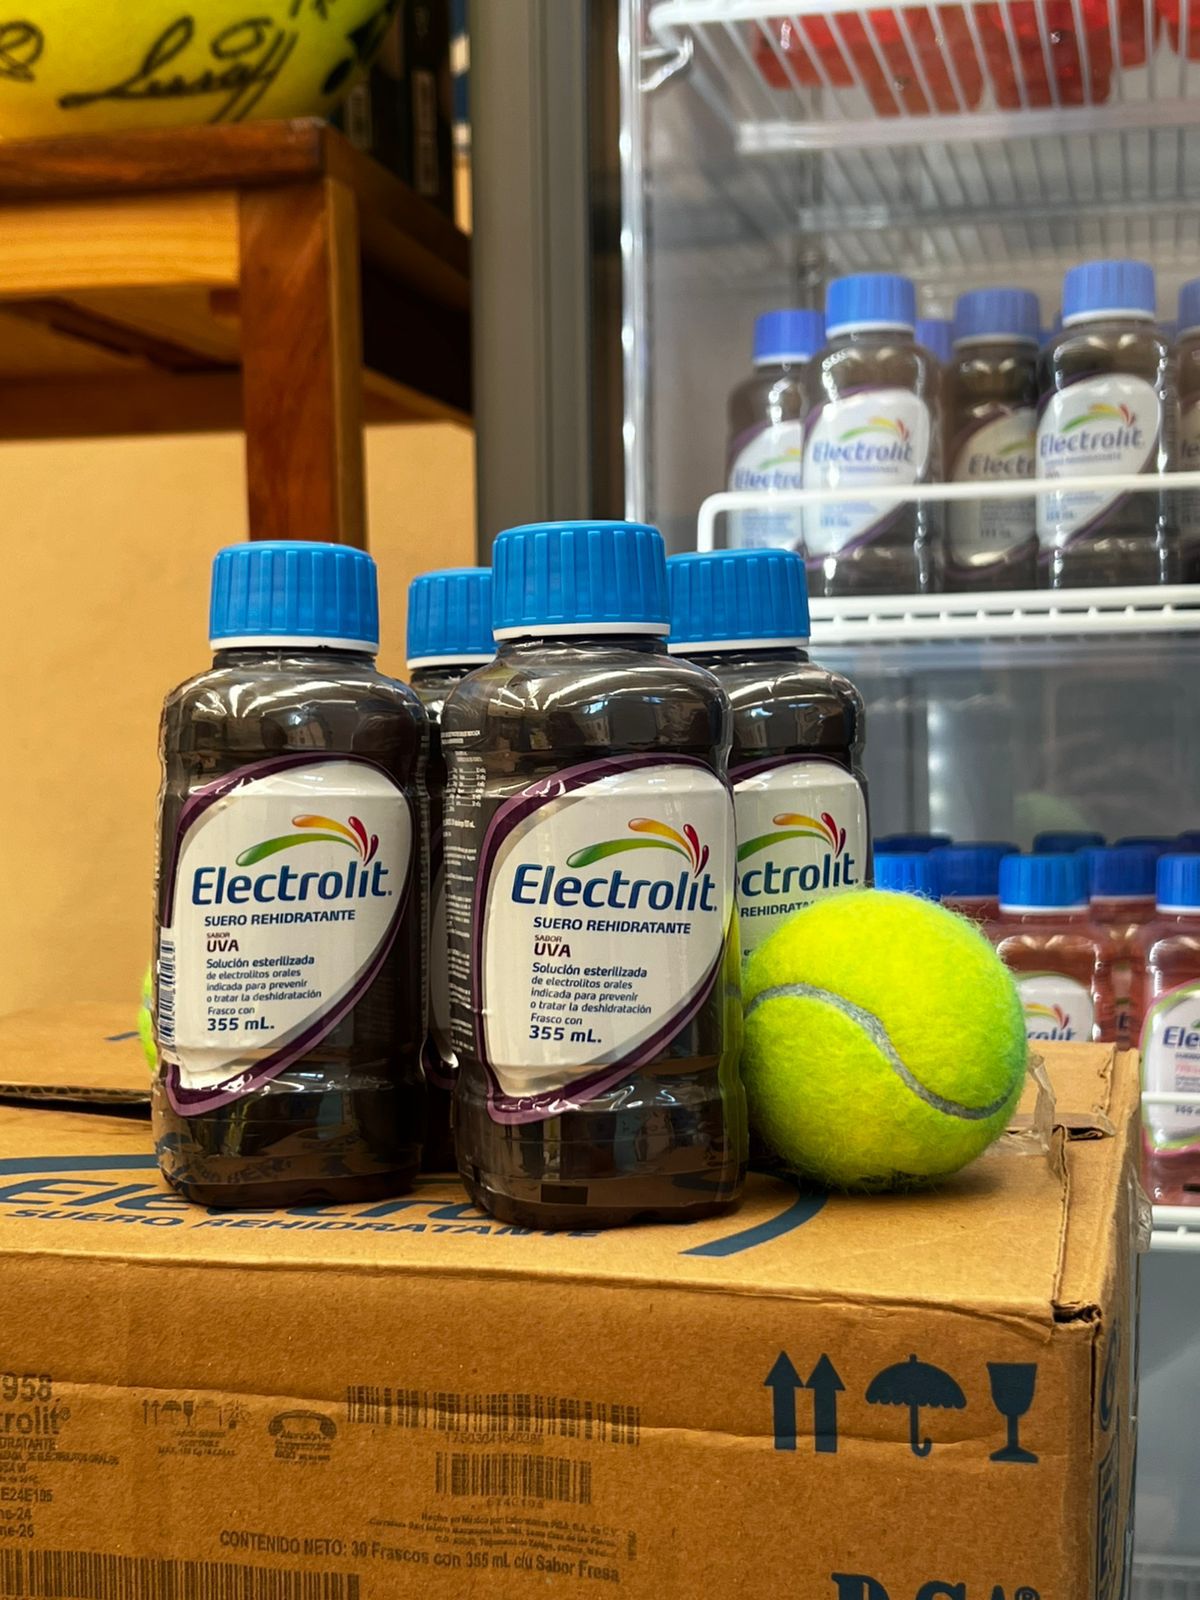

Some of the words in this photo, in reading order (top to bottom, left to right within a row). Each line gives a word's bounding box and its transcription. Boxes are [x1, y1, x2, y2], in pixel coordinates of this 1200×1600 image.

[740, 900, 815, 918] REHIDRAT
[204, 914, 247, 927] SUERO
[250, 909, 356, 925] REHIDRATANTE
[533, 916, 583, 931] SUERO
[586, 919, 692, 935] REHIDRATANTE
[206, 939, 240, 953] UVA
[534, 934, 563, 943] SABOR
[533, 942, 571, 958] UVA
[206, 957, 249, 969] Solución
[252, 954, 316, 967] esterilizada
[206, 972, 217, 980] de
[218, 970, 270, 980] electrolitos
[272, 969, 302, 978] orales
[532, 962, 580, 976] Solución
[583, 966, 648, 978] esterilizada
[206, 981, 243, 991] indicada
[245, 982, 267, 992] para
[268, 979, 308, 991] prevenir
[531, 975, 543, 985] de
[545, 976, 601, 989] electrolitos
[603, 979, 633, 990] orales
[213, 994, 238, 1003] tratar
[241, 993, 250, 1002] la
[252, 990, 322, 1002] deshidratación
[530, 987, 572, 1000] indicada
[574, 991, 597, 1001] para
[598, 992, 639, 1003] prevenir
[207, 1006, 236, 1016] Frasco
[238, 1007, 255, 1015] con
[538, 1001, 566, 1011] tratar
[568, 1002, 579, 1012] la
[581, 1003, 652, 1014] deshidratación
[207, 1017, 240, 1031] 355
[244, 1016, 275, 1031] mL.
[530, 1013, 562, 1024] Frasco
[564, 1016, 583, 1026] con
[528, 1024, 565, 1041] 355
[570, 1028, 602, 1043] mL.
[5, 1208, 185, 1227] SUERO
[219, 1529, 300, 1554] CONTENIDO
[303, 1537, 348, 1557] NETO:
[351, 1540, 368, 1558] 30
[371, 1541, 429, 1564] Frascos
[433, 1553, 461, 1568] con
[514, 1551, 533, 1569] c/u
[535, 1554, 576, 1575] Sabor
[578, 1559, 620, 1583] Fresa
